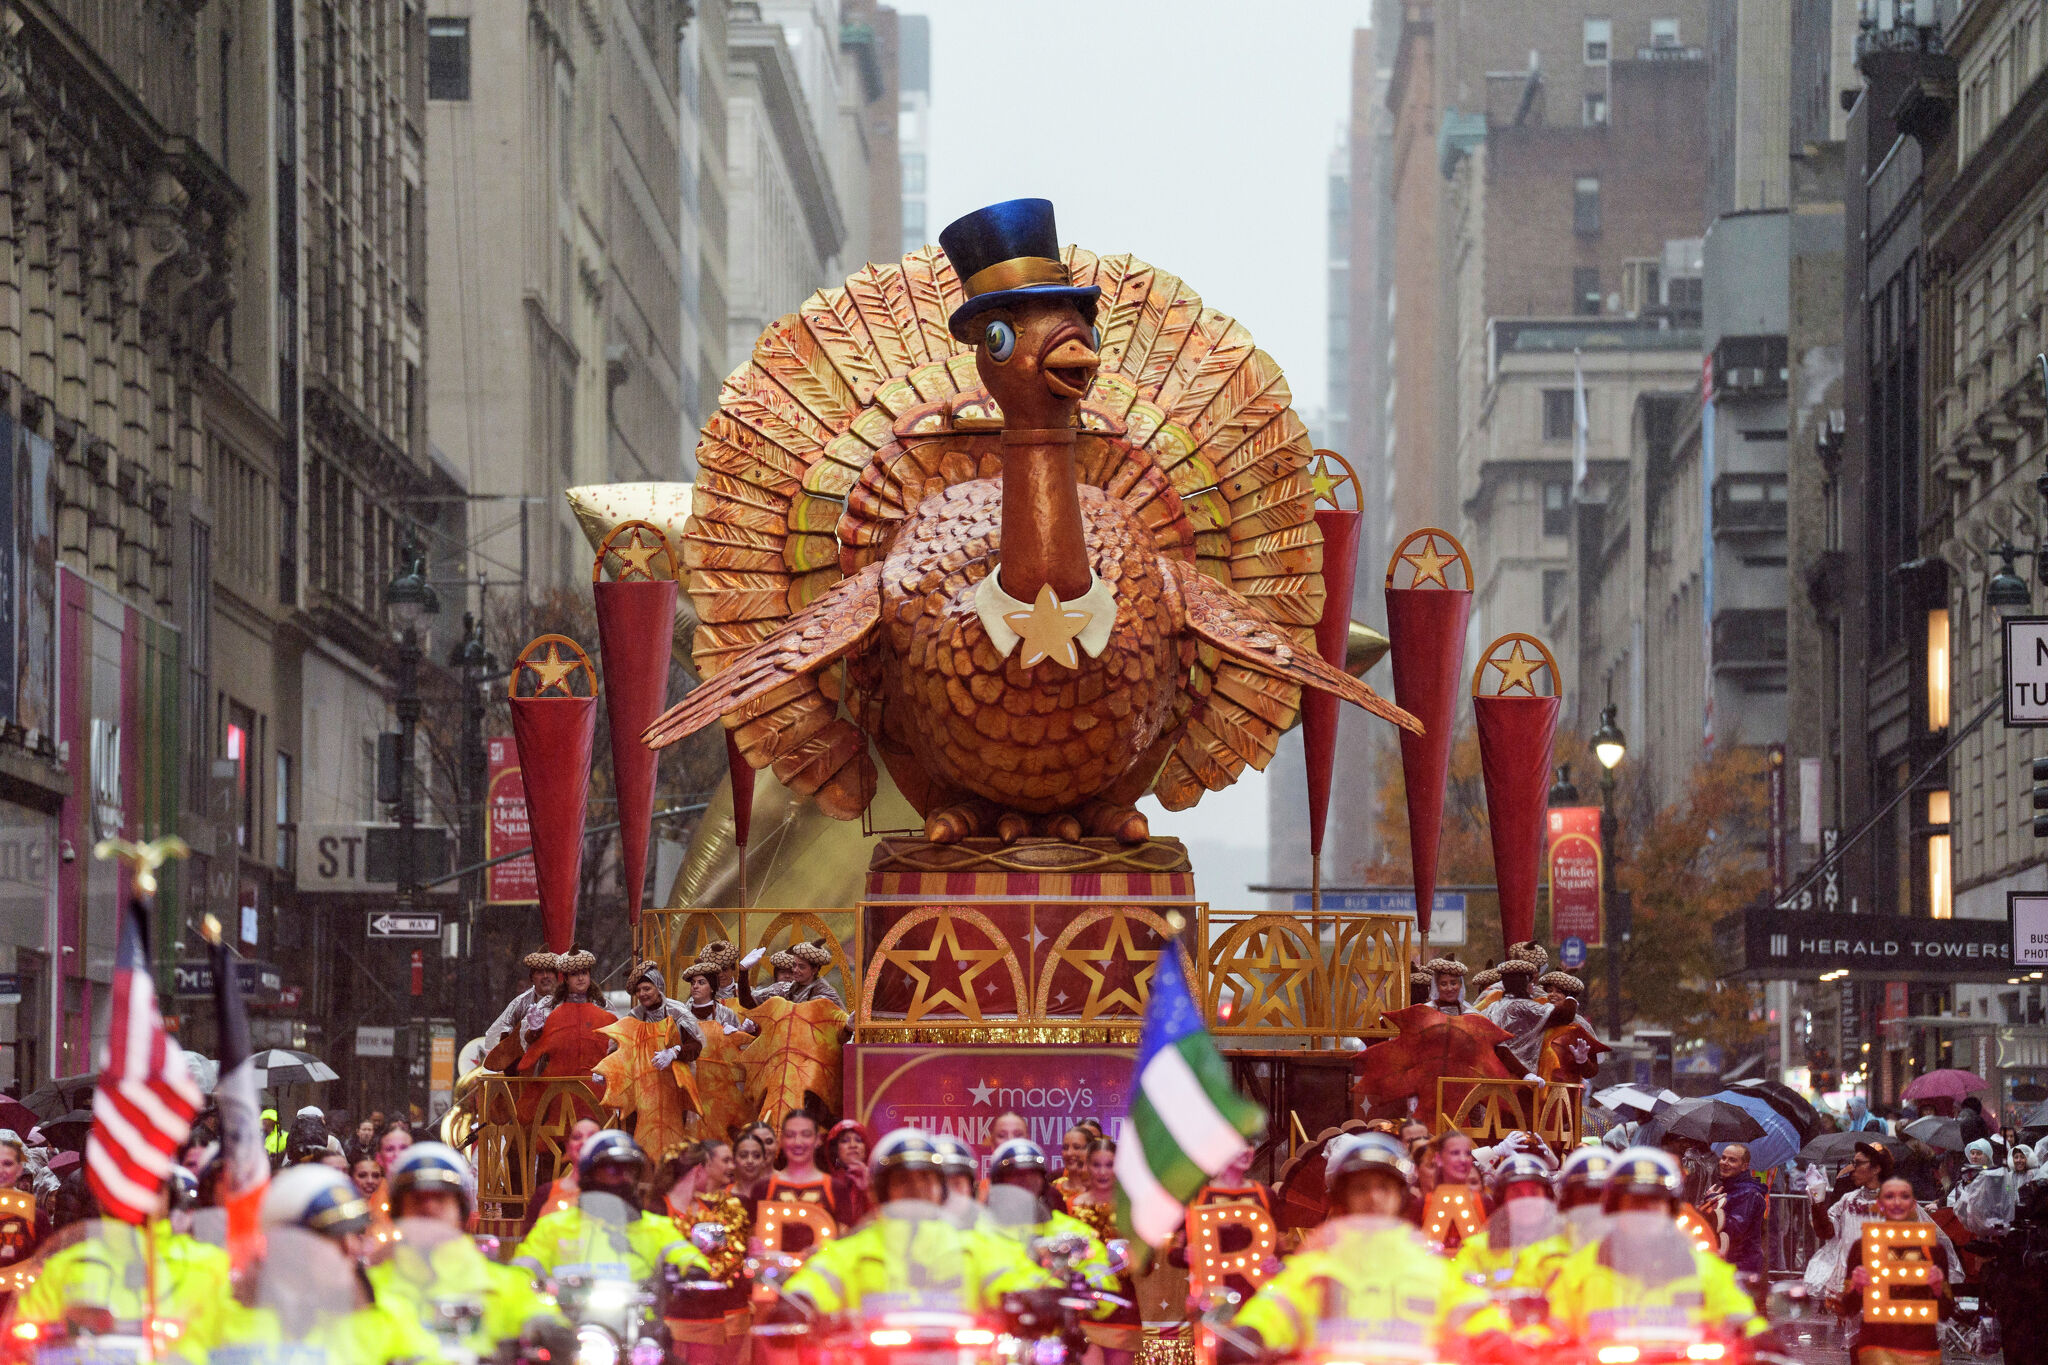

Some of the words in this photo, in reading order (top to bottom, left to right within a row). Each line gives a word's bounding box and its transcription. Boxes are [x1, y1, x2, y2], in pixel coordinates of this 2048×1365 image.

[1555, 866, 1595, 878] Holiday
[1556, 878, 1595, 891] Square
[1344, 897, 1368, 908] BUS
[1380, 897, 1411, 908] LANE
[379, 920, 398, 929] ONE
[408, 920, 430, 929] WAY
[1800, 938, 1899, 956] HERALD
[1910, 941, 2009, 959] TOWERS
[1861, 1220, 1939, 1324] E
